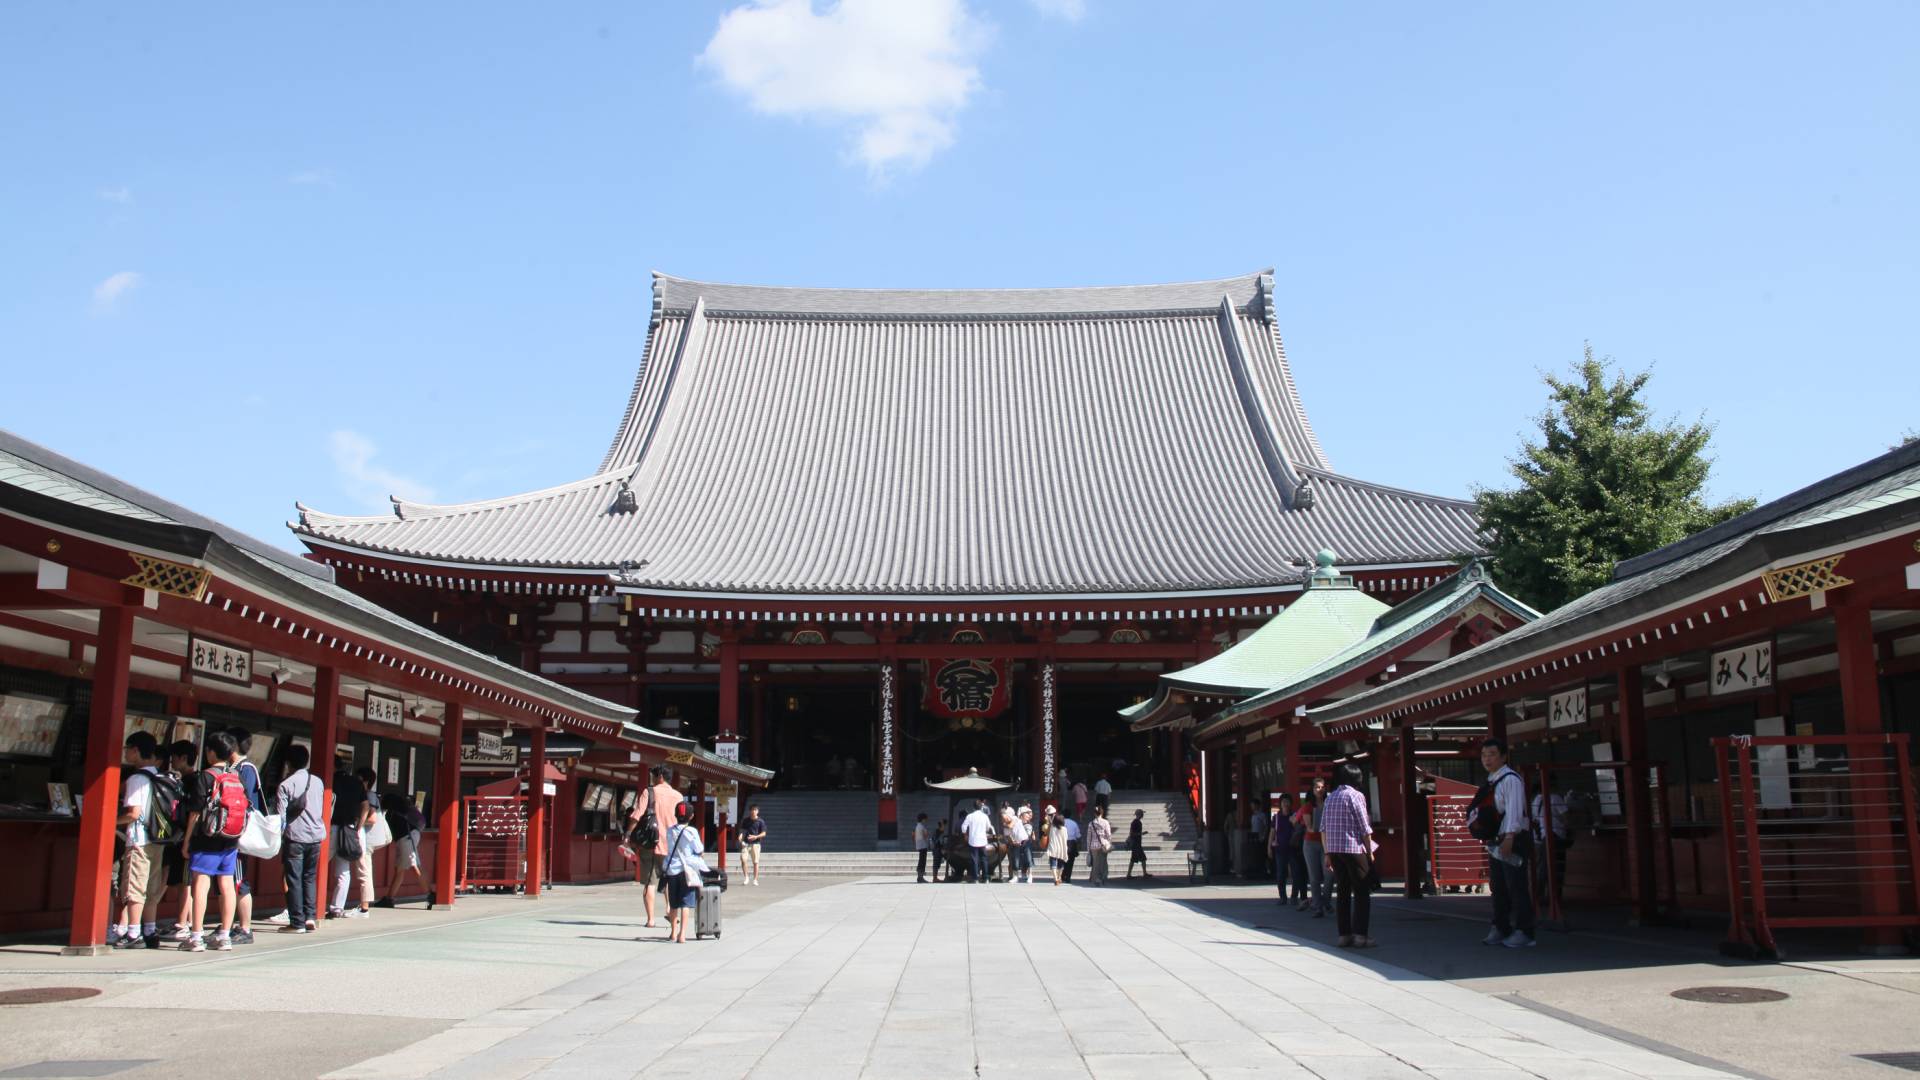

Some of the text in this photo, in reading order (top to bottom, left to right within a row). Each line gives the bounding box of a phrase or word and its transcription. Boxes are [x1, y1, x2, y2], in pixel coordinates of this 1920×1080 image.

[195, 642, 246, 677] お札お守
[1717, 647, 1769, 687] みくじ
[369, 699, 398, 722] お札お守
